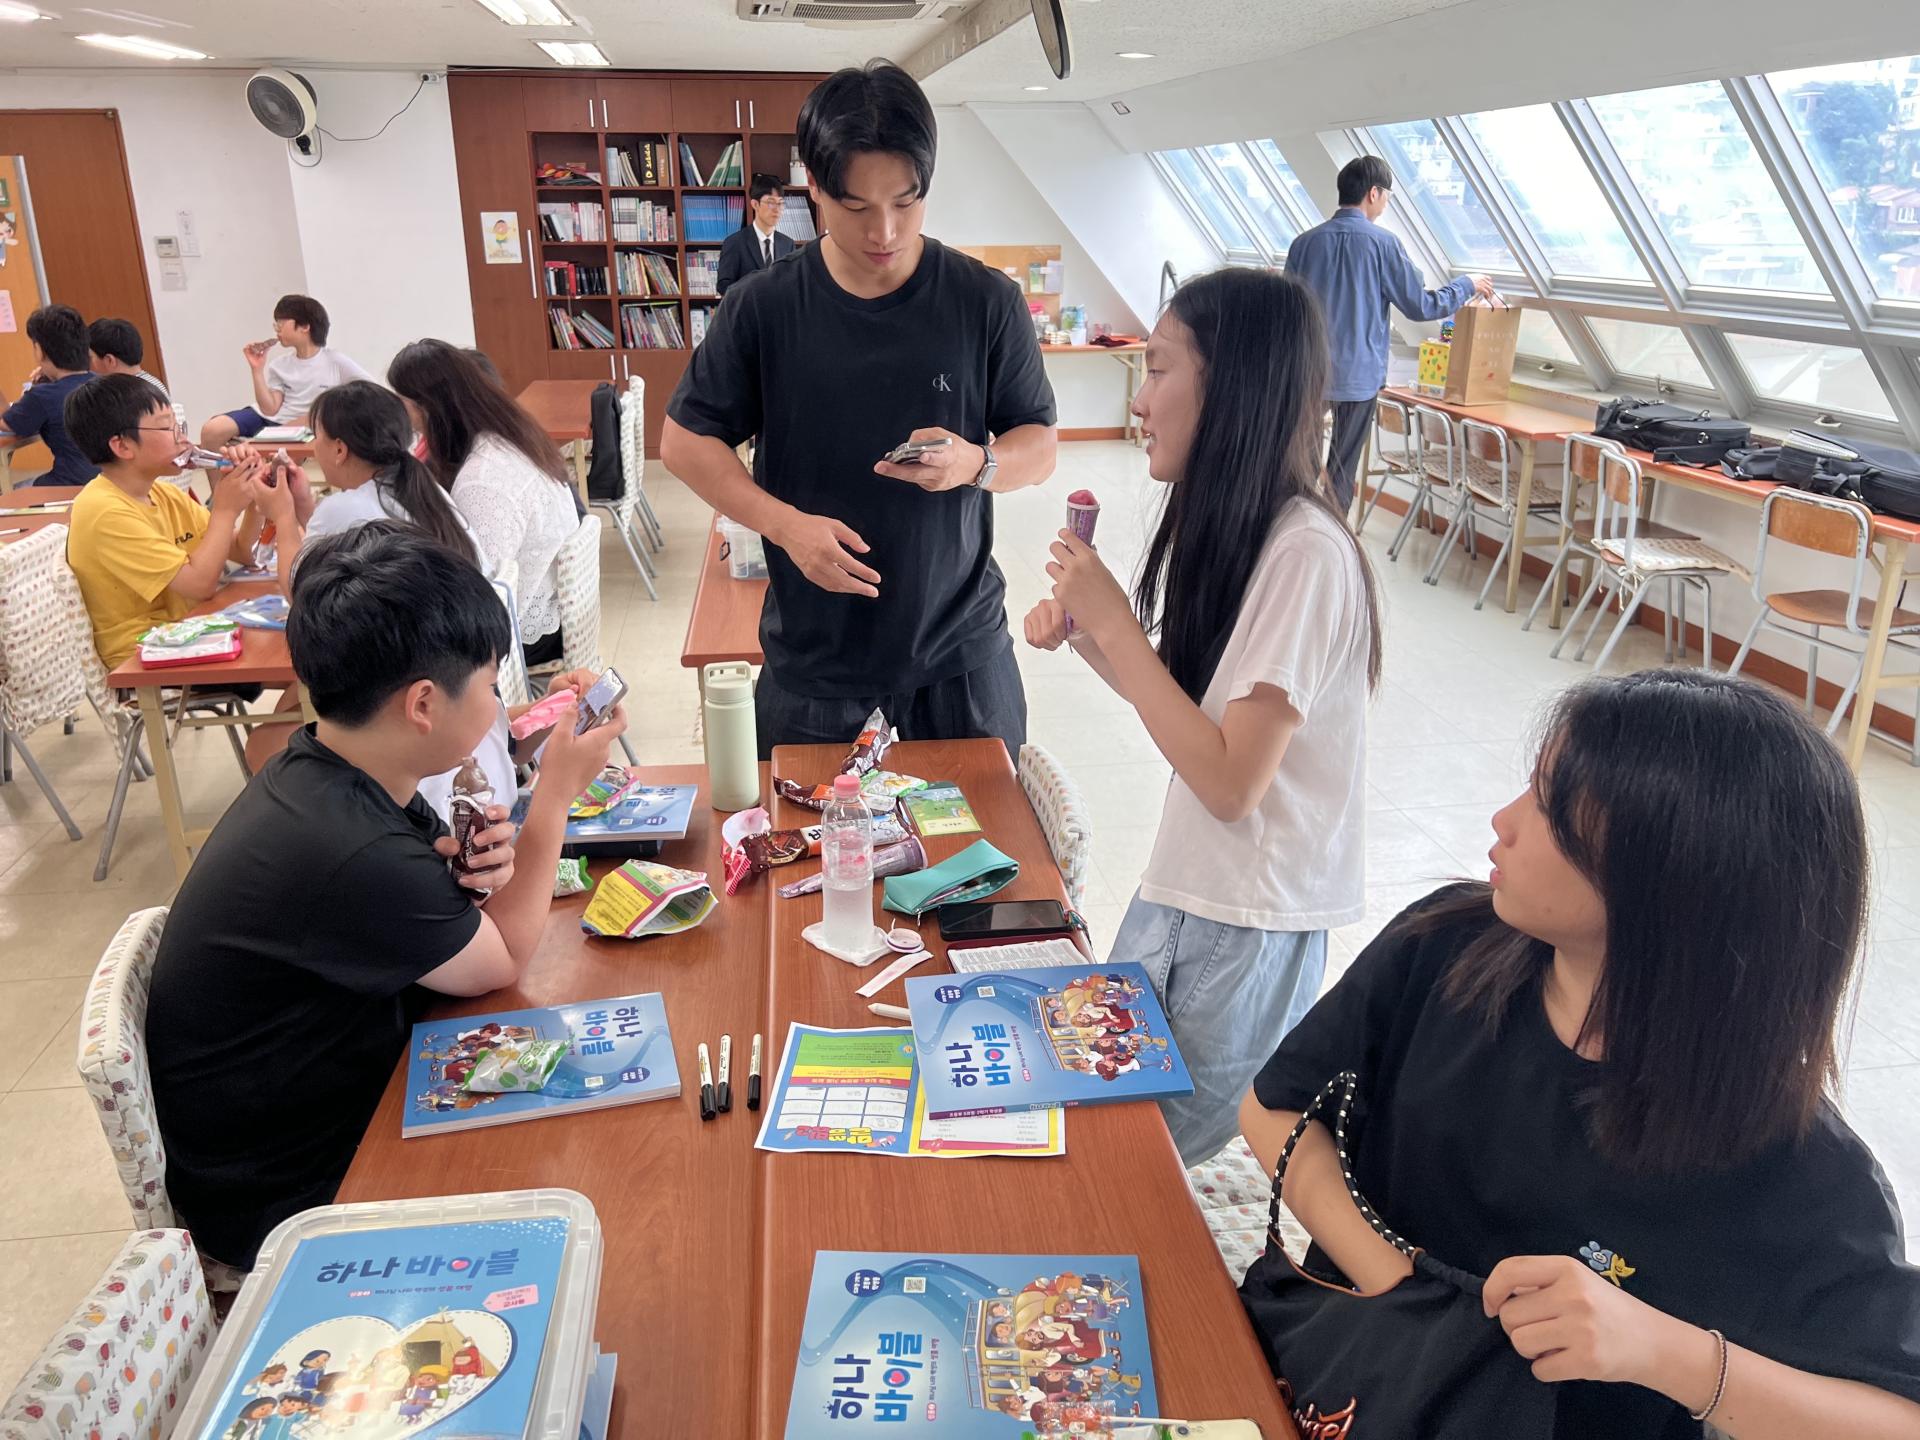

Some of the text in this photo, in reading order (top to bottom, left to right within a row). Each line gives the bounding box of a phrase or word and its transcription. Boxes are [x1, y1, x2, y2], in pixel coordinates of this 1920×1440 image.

[579, 1009, 616, 1056] 바이블
[612, 1006, 643, 1038] 하나
[945, 1043, 979, 1087] 하나
[972, 1024, 1011, 1086] 바이블
[317, 1248, 520, 1284] 하나 바이블
[830, 1354, 871, 1420] 하나
[874, 1331, 923, 1422] 바이블
